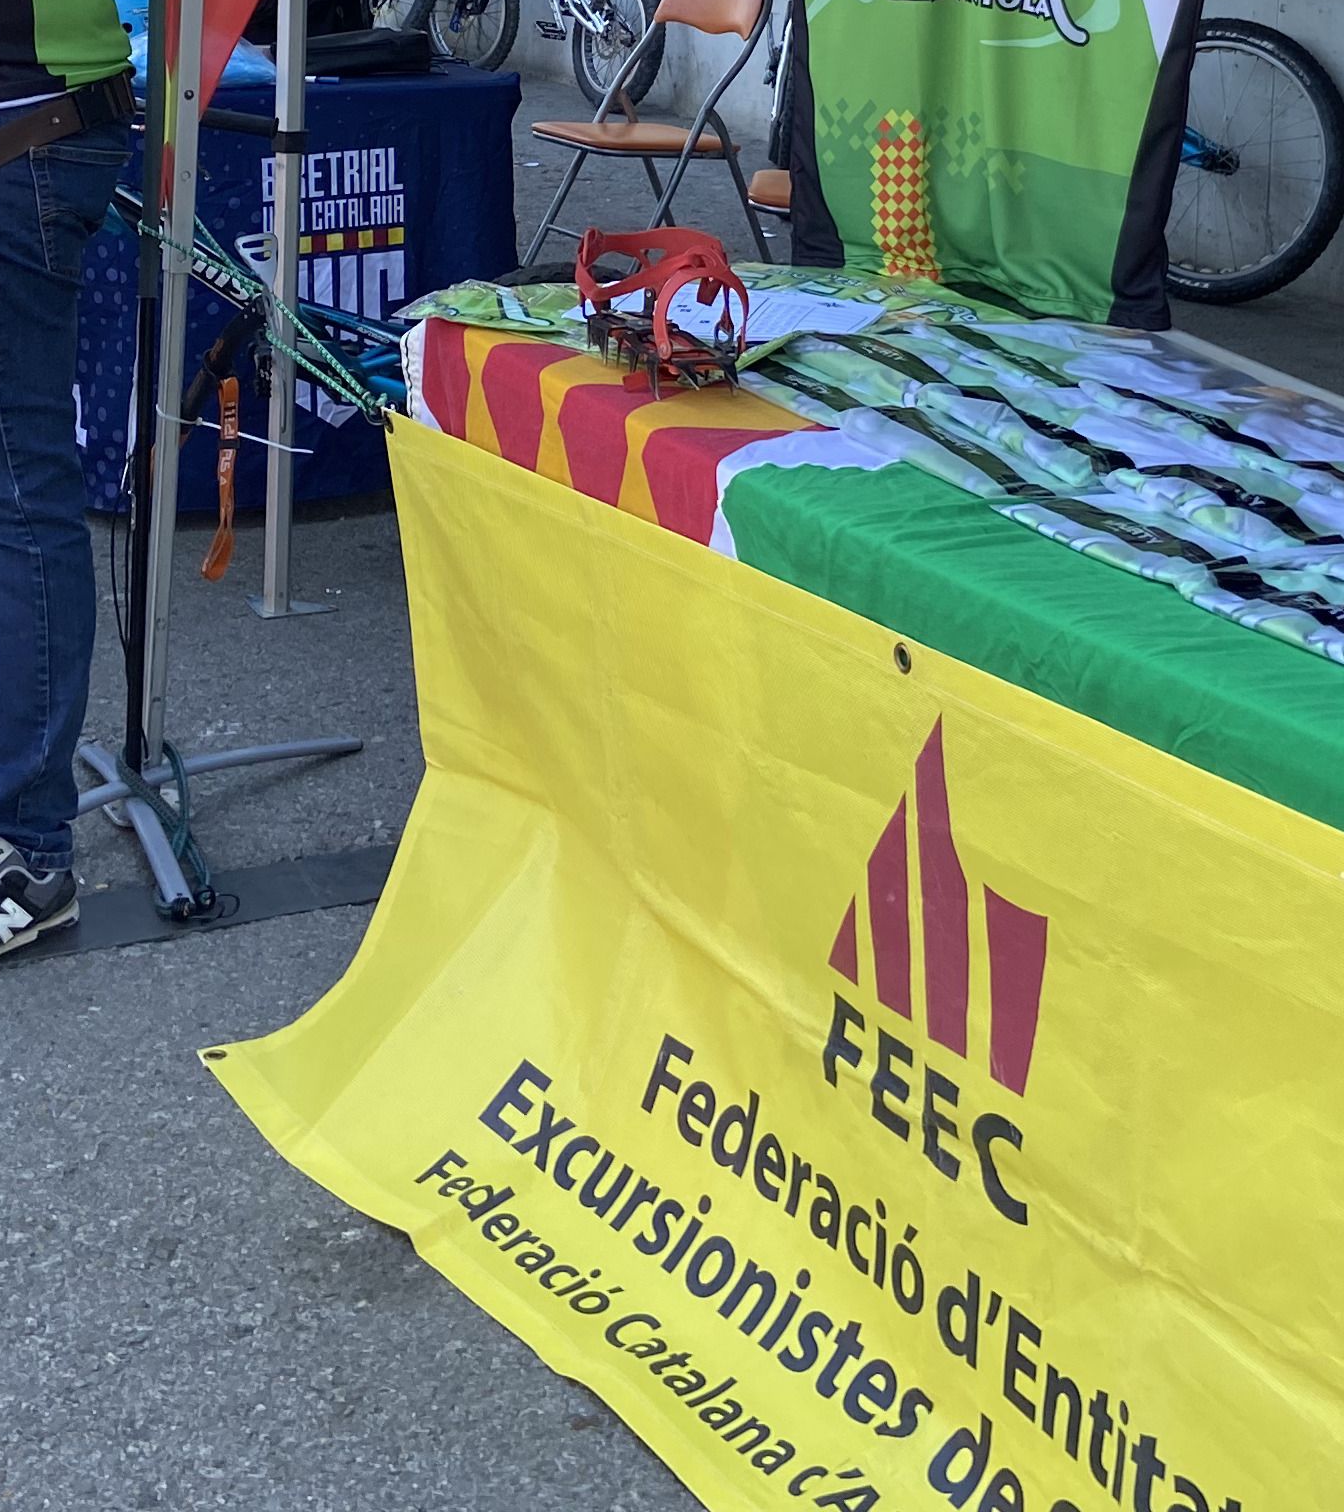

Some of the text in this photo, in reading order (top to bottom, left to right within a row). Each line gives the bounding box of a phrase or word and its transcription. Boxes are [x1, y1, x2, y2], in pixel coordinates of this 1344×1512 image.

[311, 193, 405, 232] CATALANA
[478, 1058, 935, 1438] Excursionistes
[640, 1033, 1242, 1512] Federació d'Entita
[822, 992, 1029, 1226] FEEC
[414, 1147, 612, 1317] Federació
[602, 1310, 796, 1476] Catalana
